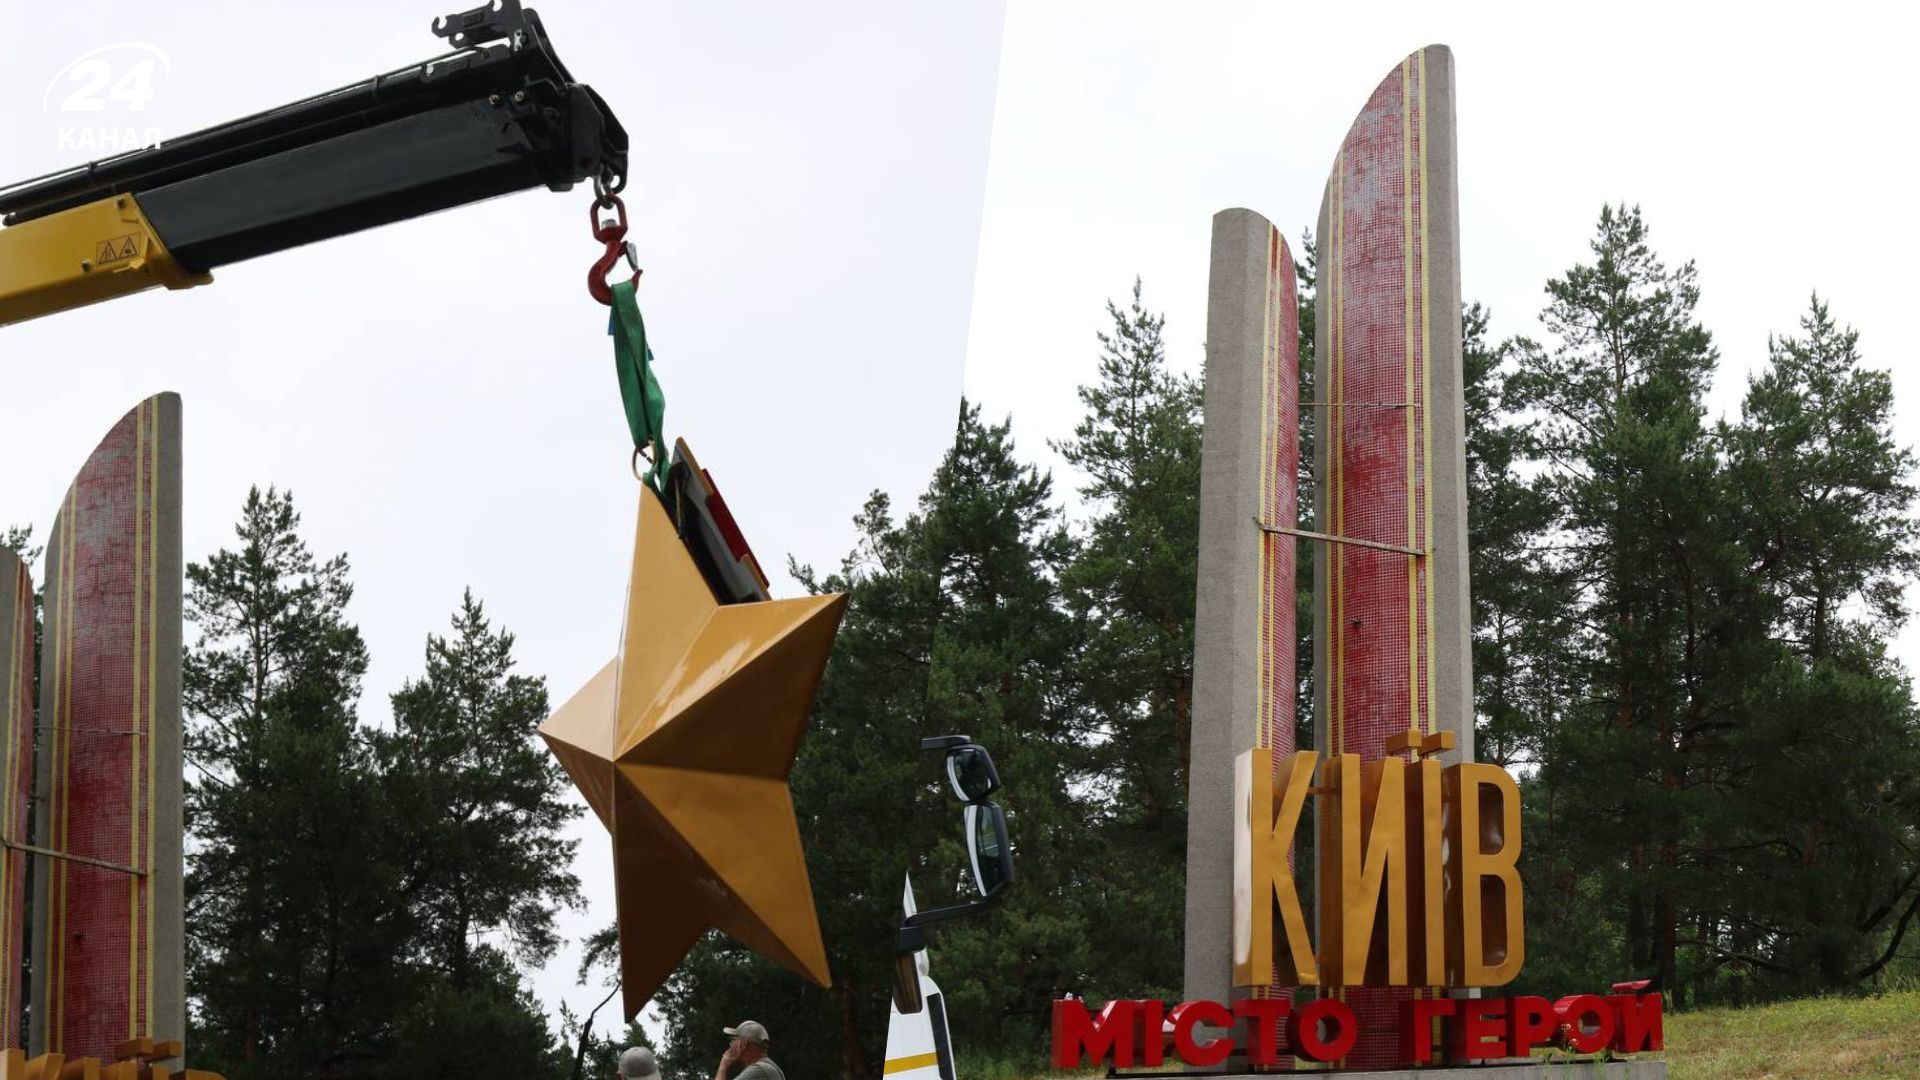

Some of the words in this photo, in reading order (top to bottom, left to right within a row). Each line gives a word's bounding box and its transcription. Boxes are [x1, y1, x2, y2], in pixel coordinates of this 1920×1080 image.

[1233, 730, 1525, 987] КИЇВ
[1051, 998, 1358, 1070] МІСТО
[1412, 980, 1665, 1062] ГЕРОЙ
